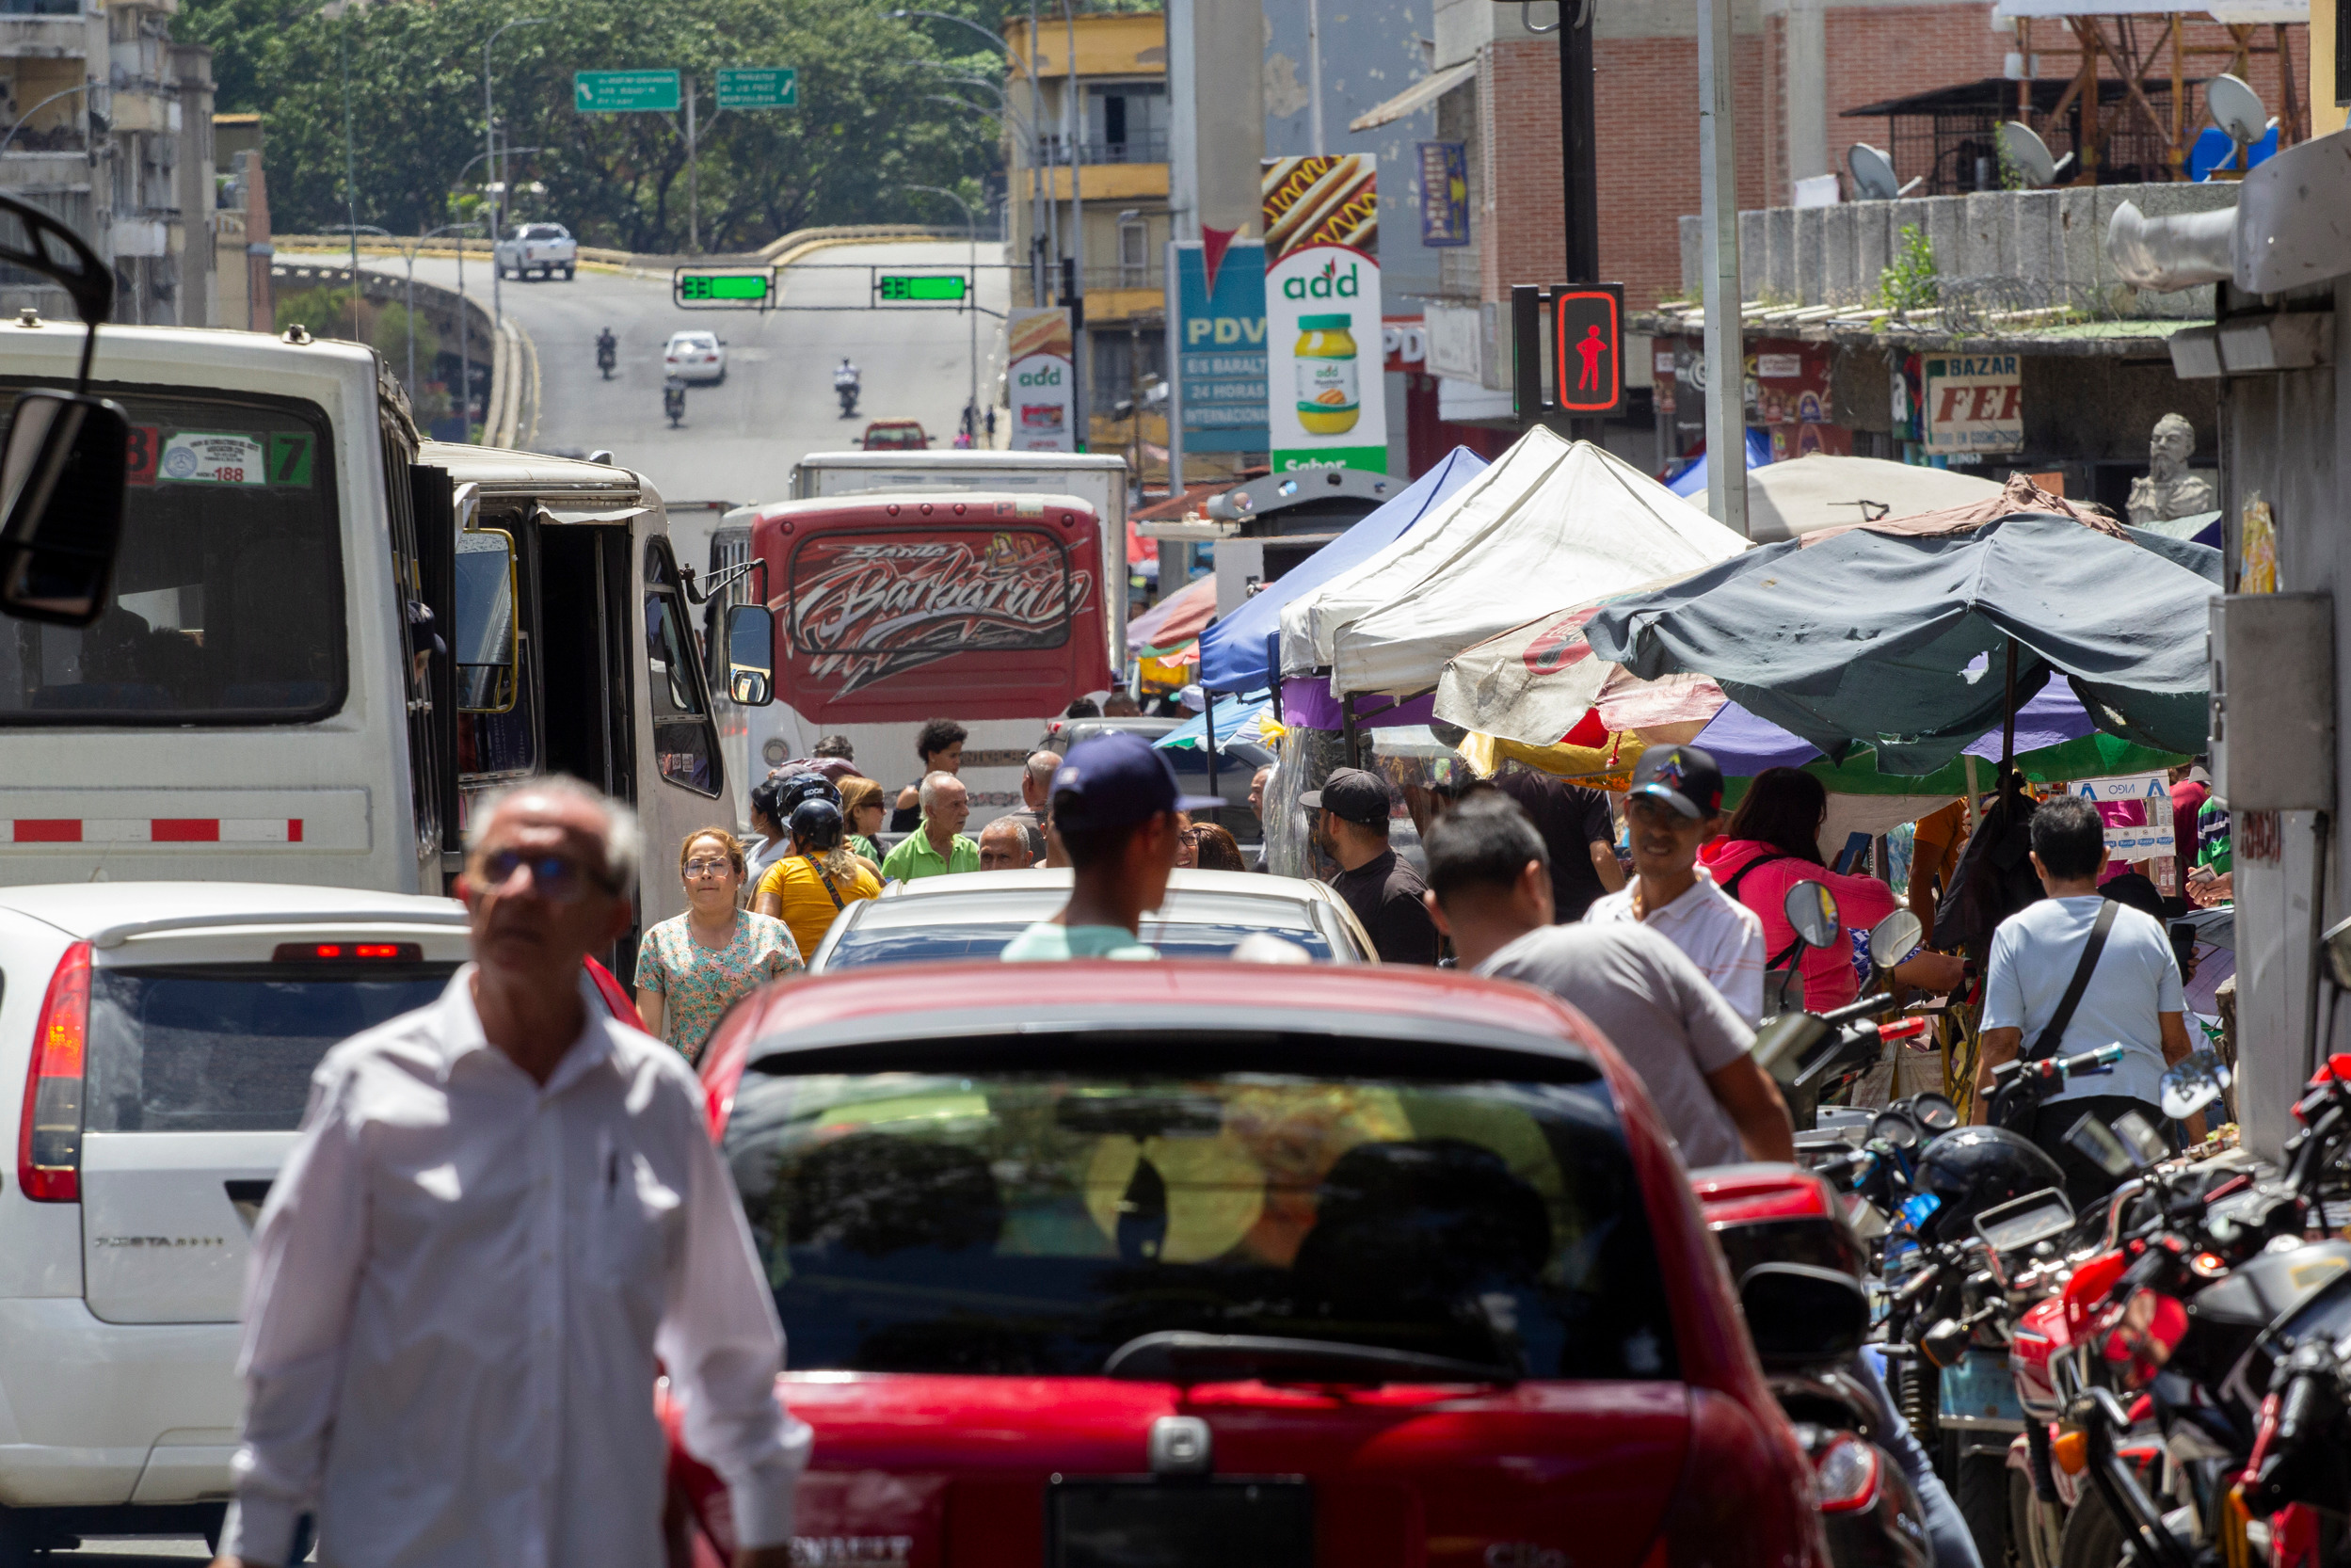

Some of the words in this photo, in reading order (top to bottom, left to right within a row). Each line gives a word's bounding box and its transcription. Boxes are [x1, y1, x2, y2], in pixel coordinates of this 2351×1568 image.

[1283, 263, 1359, 299] add
[1187, 317, 1267, 345] PDV
[1949, 357, 2018, 376] BAZAR
[279, 438, 307, 481] 7
[215, 467, 244, 482] 188
[804, 788, 824, 796] EDGE
[2108, 783, 2135, 795] VIGO
